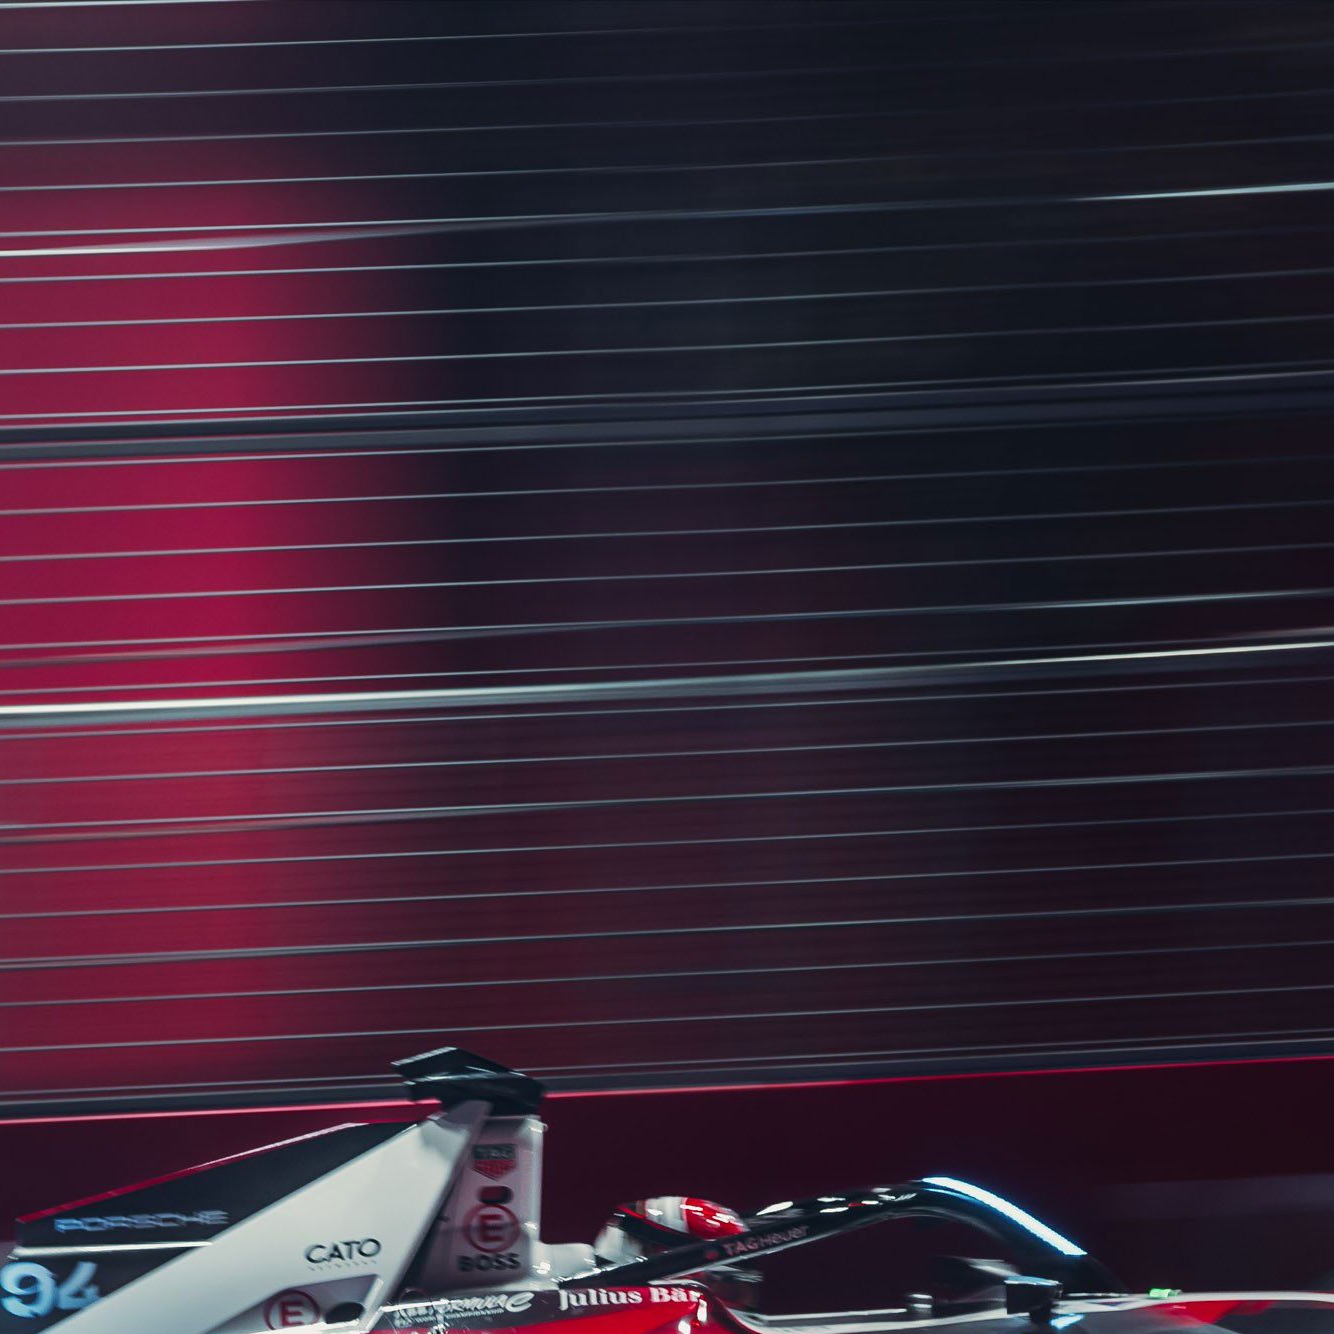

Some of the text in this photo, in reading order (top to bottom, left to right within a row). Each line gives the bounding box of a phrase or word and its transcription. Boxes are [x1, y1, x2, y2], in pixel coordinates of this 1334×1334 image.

[304, 1238, 381, 1264] CATO
[458, 1252, 521, 1272] BOSS
[558, 1286, 702, 1311] Julius Bär
